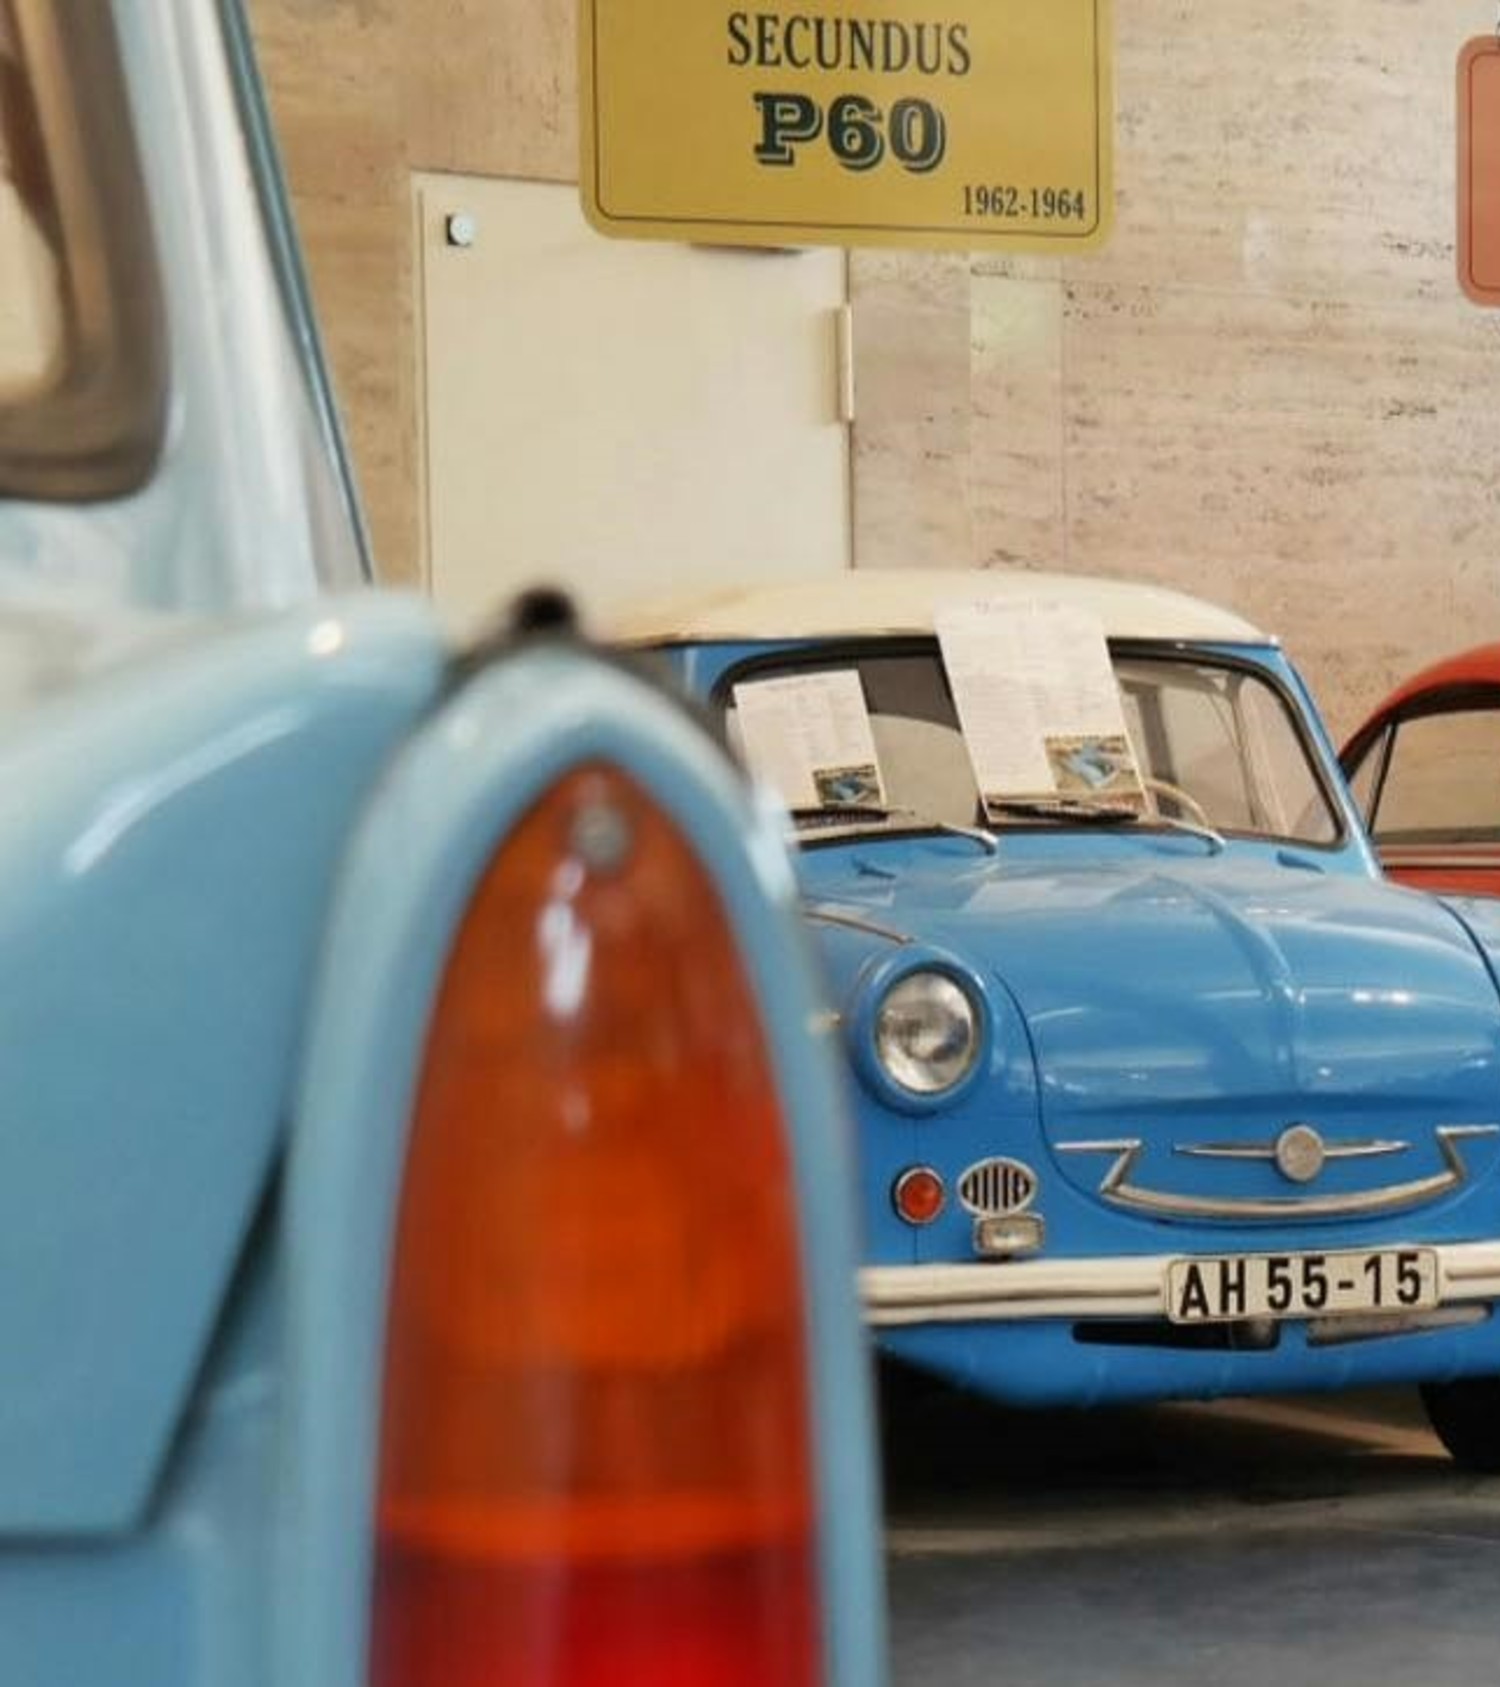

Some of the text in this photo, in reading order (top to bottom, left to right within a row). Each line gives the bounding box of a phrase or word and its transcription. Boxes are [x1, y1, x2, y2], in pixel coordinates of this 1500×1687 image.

[727, 12, 972, 76] SECUNDUS
[752, 91, 946, 174] P60
[962, 184, 1085, 221] 1962-1964
[1179, 1251, 1421, 1318] AH 55-15
